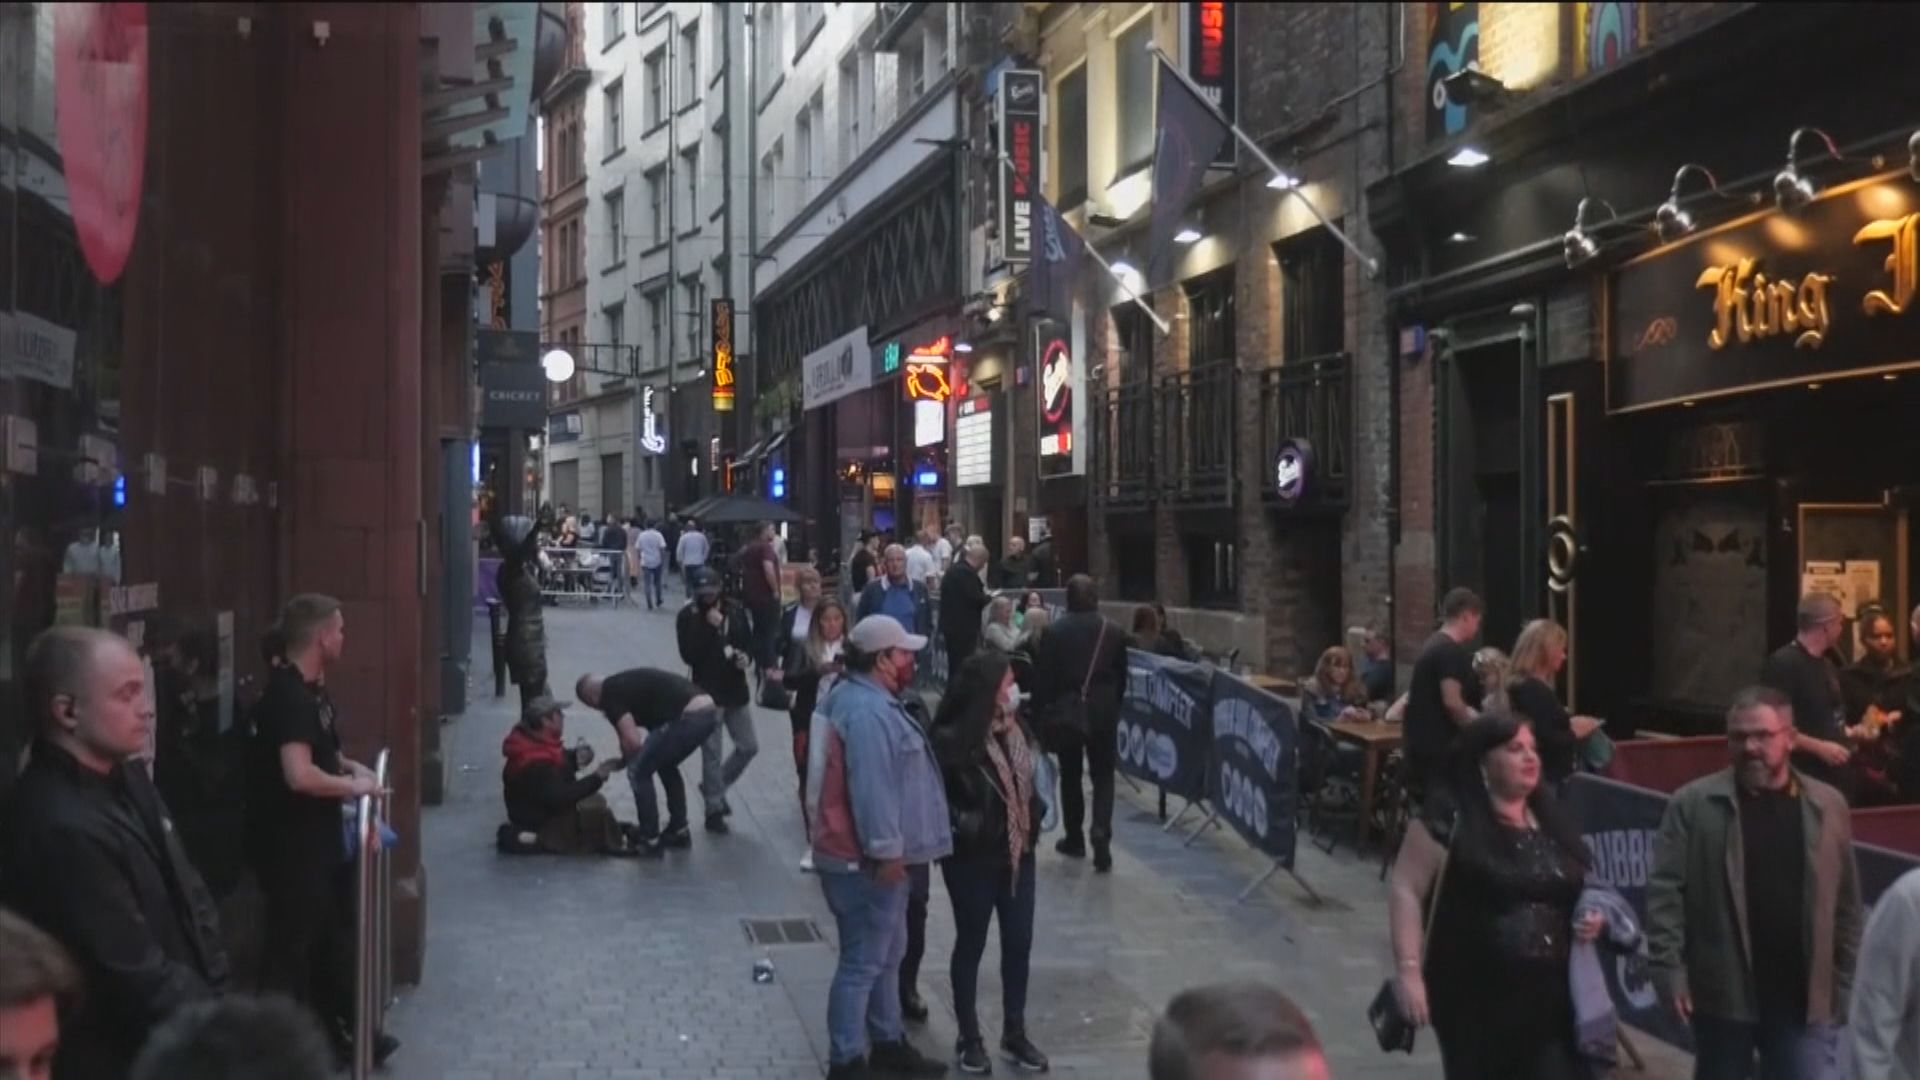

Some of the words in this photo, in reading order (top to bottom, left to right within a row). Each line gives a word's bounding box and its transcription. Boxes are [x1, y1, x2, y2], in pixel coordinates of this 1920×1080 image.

[1013, 120, 1031, 195] MUSIC
[1014, 201, 1031, 251] LIVE
[1696, 258, 1835, 349] King
[489, 390, 541, 400] CRICKET
